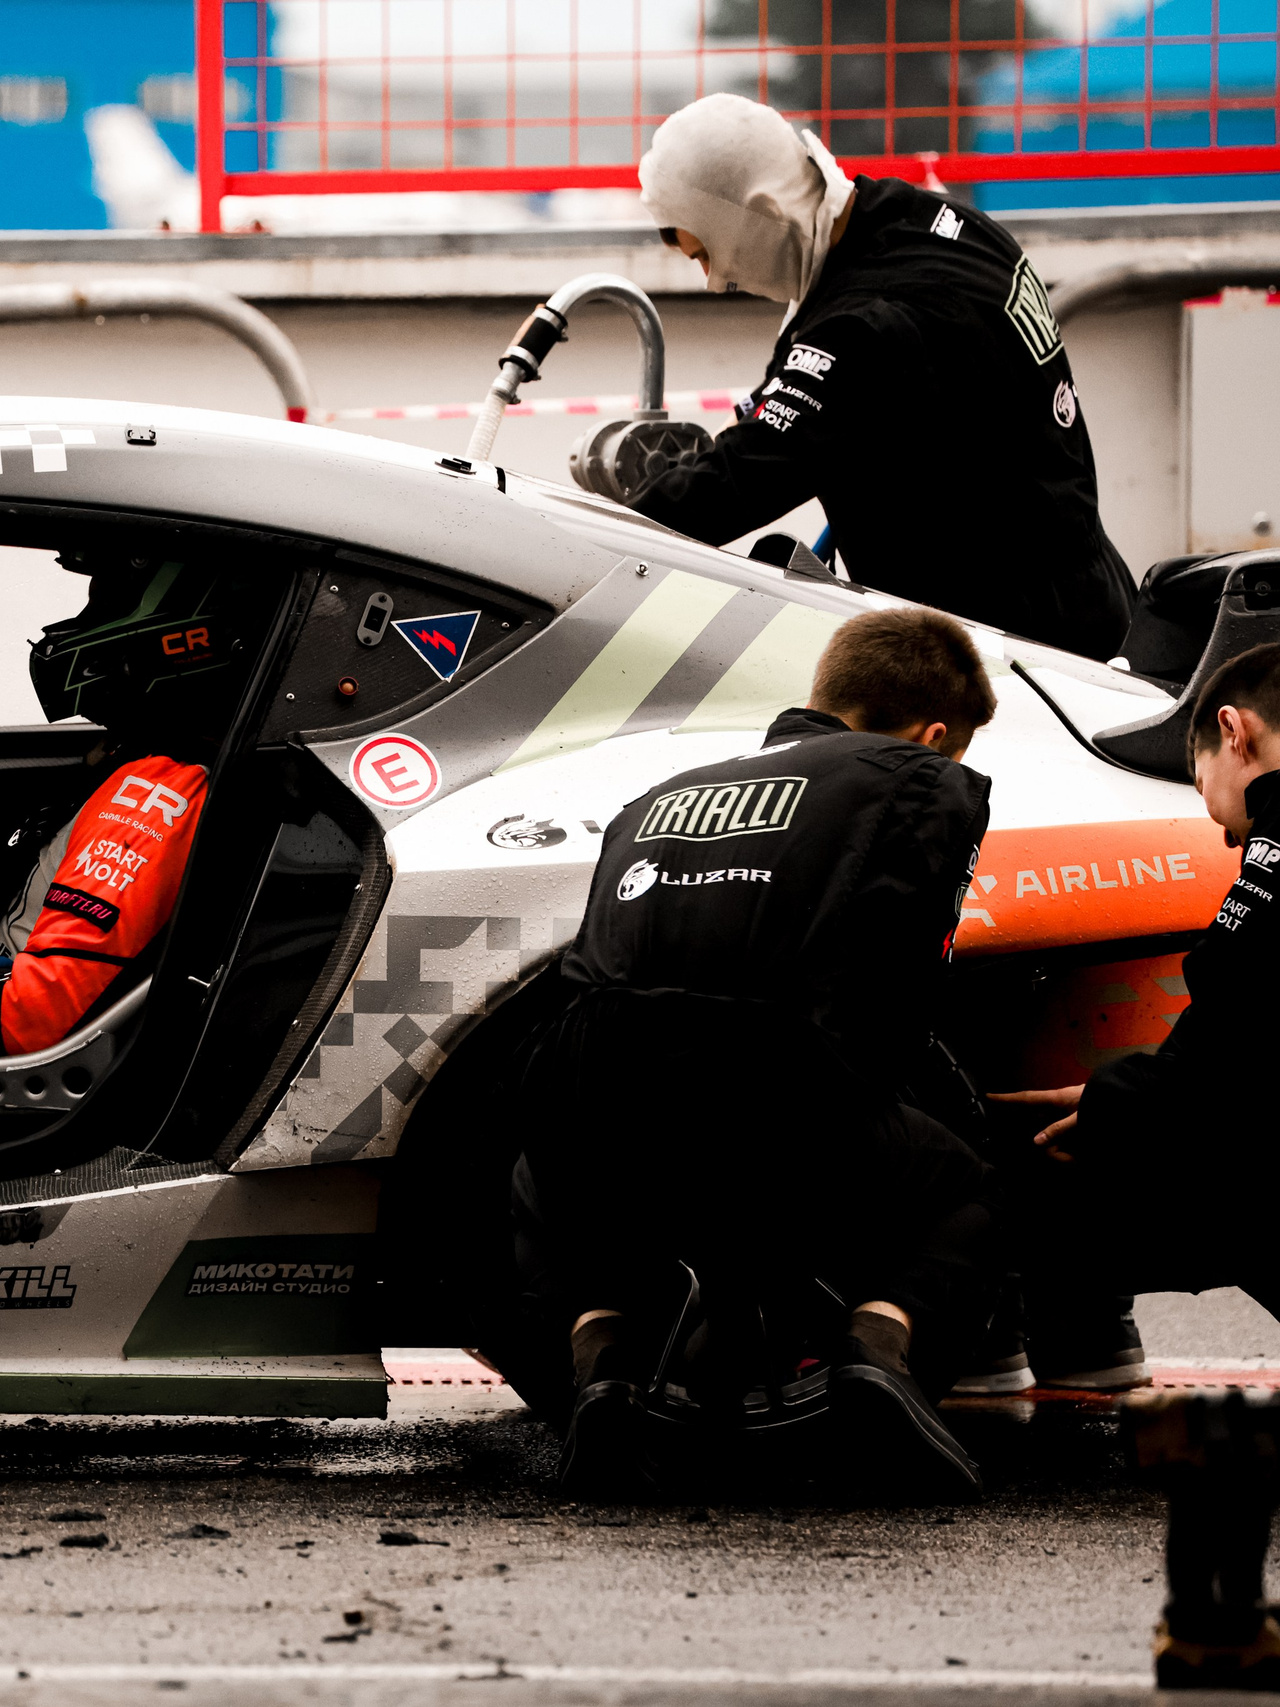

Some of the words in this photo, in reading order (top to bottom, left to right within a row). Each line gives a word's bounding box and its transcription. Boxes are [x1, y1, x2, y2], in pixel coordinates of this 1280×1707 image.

[786, 347, 833, 375] OMP
[758, 409, 792, 432] VOLT
[765, 399, 801, 421] START
[161, 627, 210, 655] CR
[371, 752, 420, 794] E
[111, 775, 188, 827] CR
[646, 782, 795, 835] TRIALLI
[131, 820, 164, 842] RACING
[94, 839, 148, 873] START
[83, 857, 135, 891] VOLT
[660, 867, 773, 886] LUZAR
[1016, 853, 1196, 898] AIRLINE
[1222, 897, 1252, 918] TART
[1216, 910, 1243, 931] OLT
[193, 1263, 354, 1280] МИКОТАТИ
[188, 1280, 267, 1294] ДИЗАЙН
[272, 1282, 351, 1294] СТУДИО
